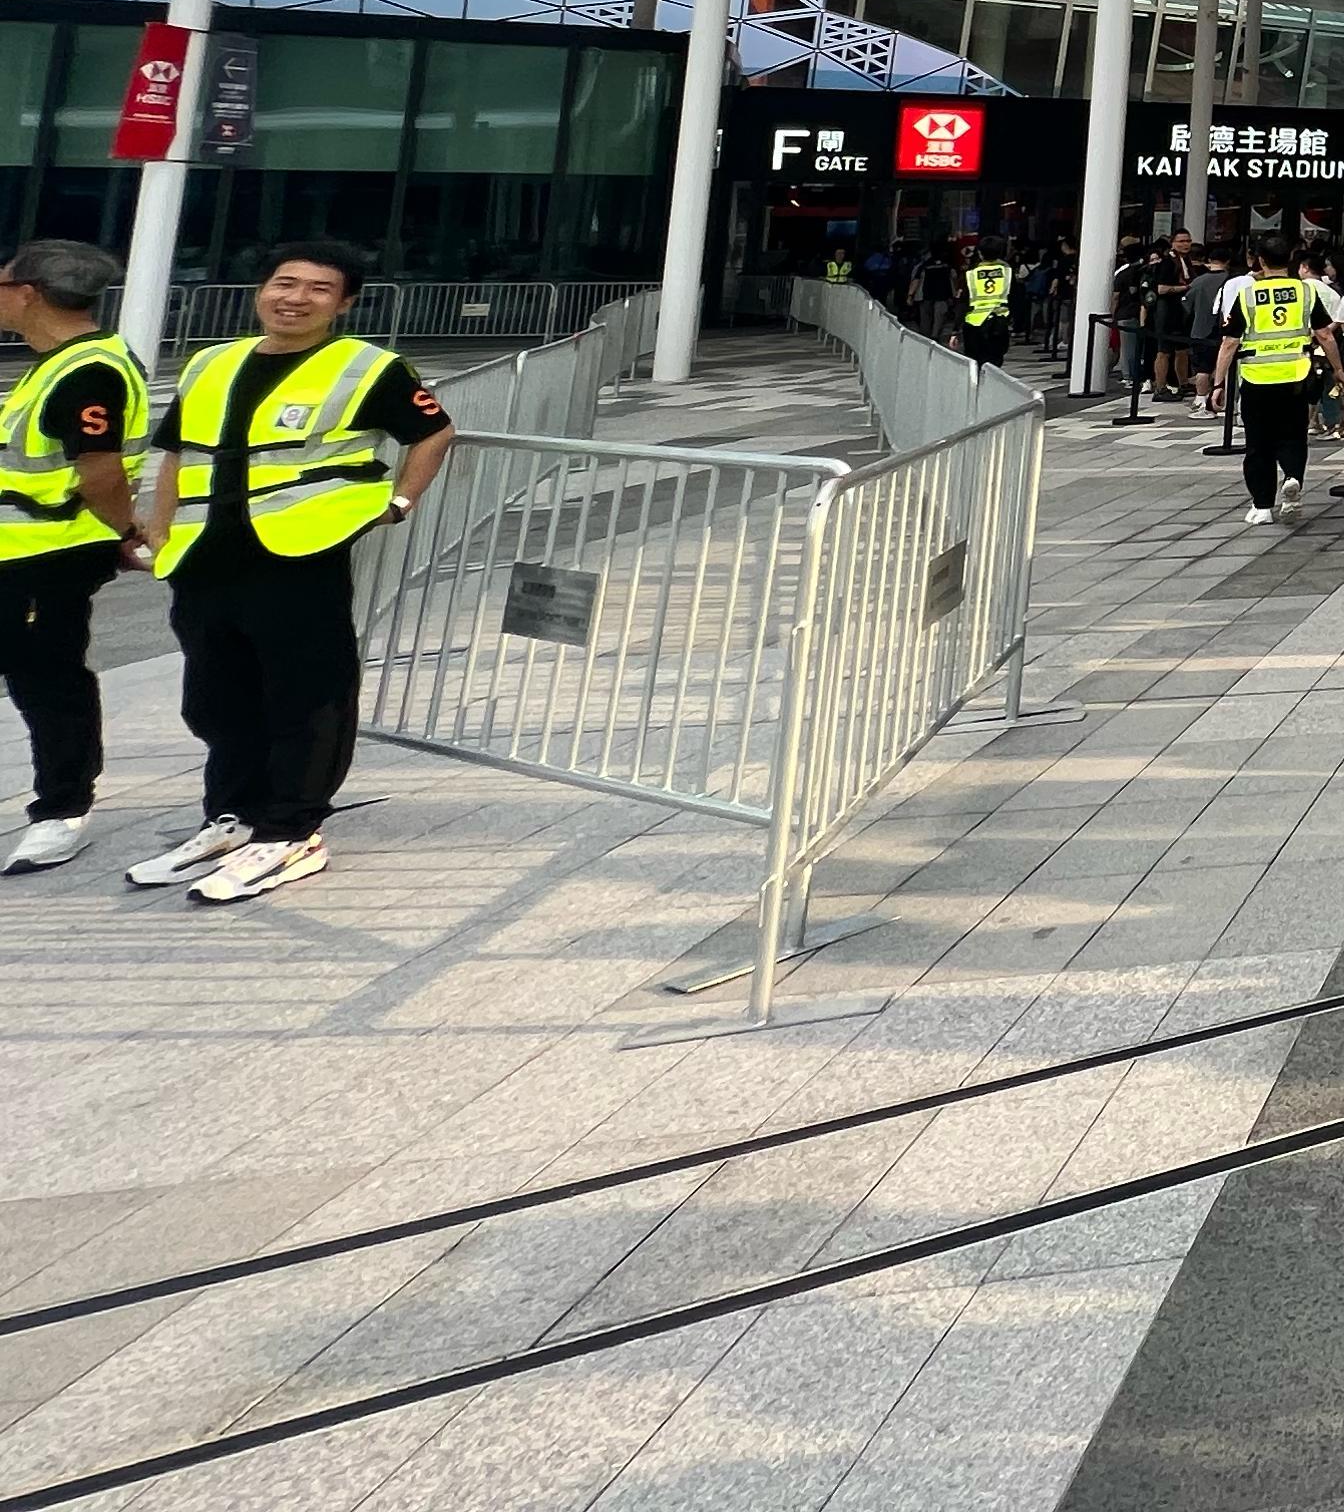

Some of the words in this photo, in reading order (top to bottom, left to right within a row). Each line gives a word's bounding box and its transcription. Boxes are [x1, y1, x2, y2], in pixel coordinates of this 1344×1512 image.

[771, 129, 811, 171] F
[816, 130, 845, 153] 閘
[815, 155, 869, 172] GATE
[915, 153, 963, 168] HSBC
[1136, 156, 1182, 177] KAI
[1206, 157, 1240, 178] AK
[1257, 291, 1268, 303] D
[1274, 289, 1297, 303] 393
[80, 405, 109, 436] S
